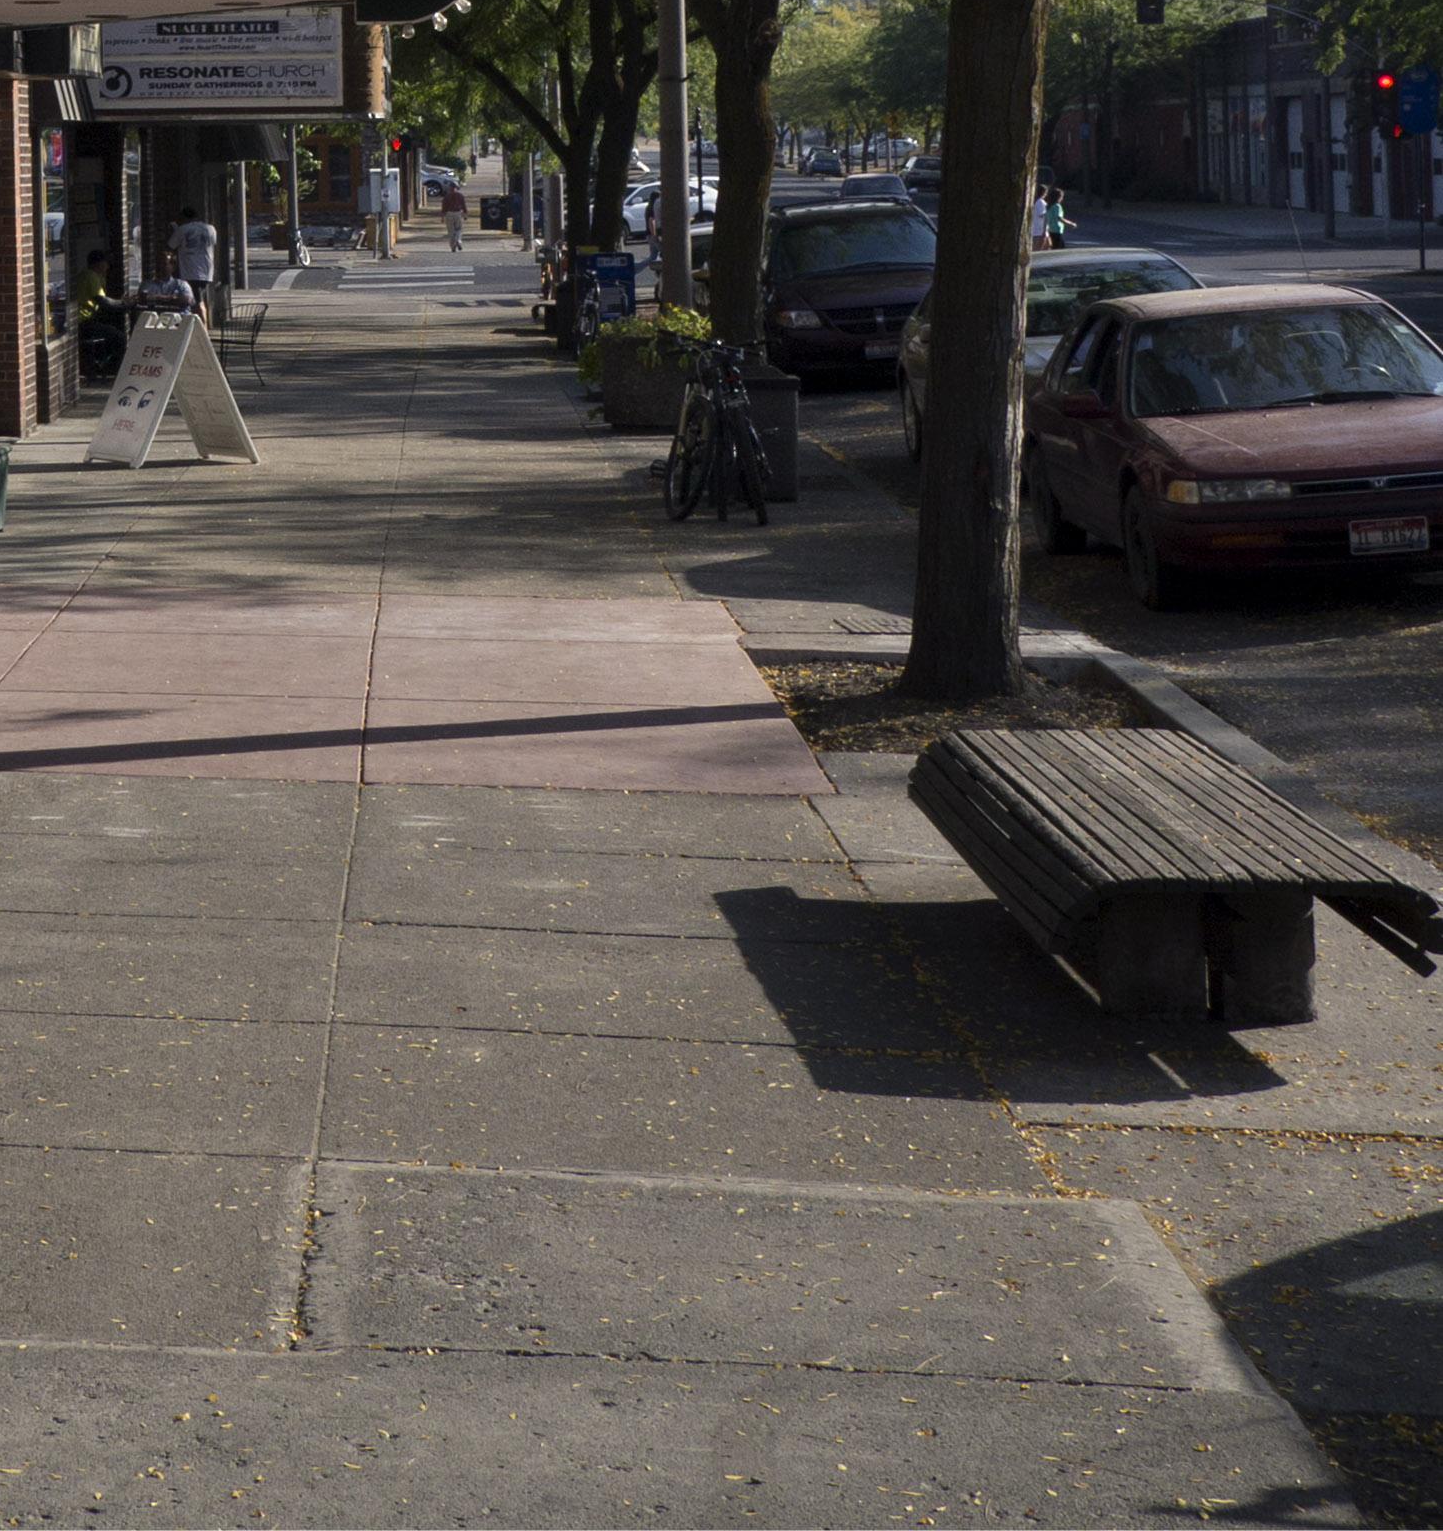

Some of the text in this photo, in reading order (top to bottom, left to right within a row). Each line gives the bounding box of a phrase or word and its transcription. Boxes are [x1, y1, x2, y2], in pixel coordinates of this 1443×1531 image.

[148, 81, 191, 90] SUNDAY
[194, 80, 263, 89] GATHERINGS
[300, 80, 317, 88] PM
[142, 345, 163, 359] EYE
[128, 364, 163, 378] EXAMS
[112, 418, 136, 433] HERE
